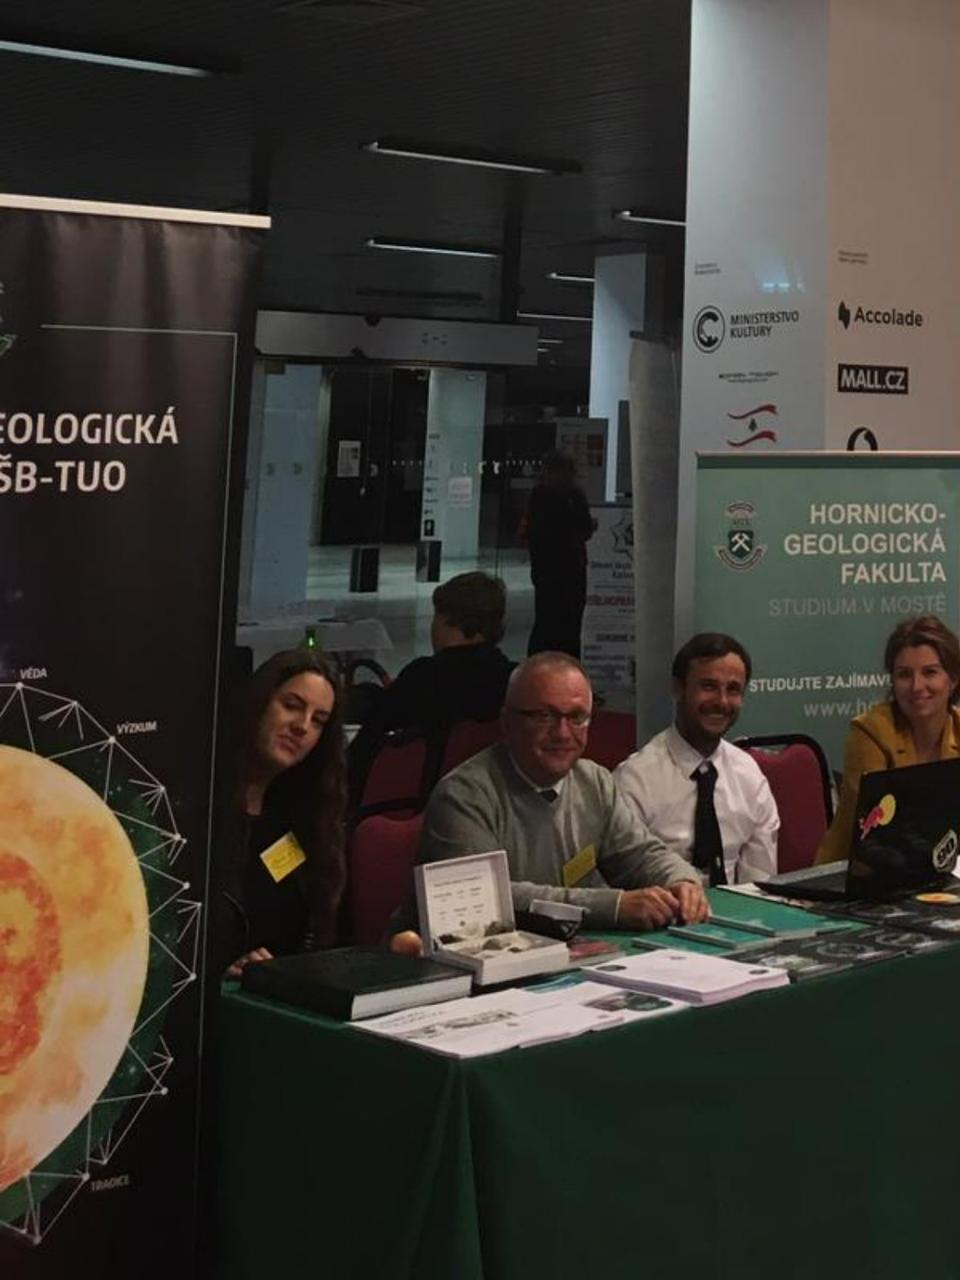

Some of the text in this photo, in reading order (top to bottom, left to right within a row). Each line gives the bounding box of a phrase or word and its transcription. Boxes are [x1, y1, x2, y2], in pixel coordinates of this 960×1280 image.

[730, 311, 800, 325] MINISTERSTVO
[853, 307, 923, 327] Accolade
[730, 327, 772, 339] KULTURY
[841, 369, 905, 391] MALL.CZ
[810, 503, 947, 524] HORNICKO-
[784, 528, 947, 555] GEOLOGICKÁ
[841, 562, 947, 584] FAKULTA
[769, 592, 947, 617] STUDIUM V MOSTĚ
[20, 667, 48, 680] VĚDA
[750, 675, 822, 692] STUDUJTE
[117, 720, 157, 734] VÝZKUM
